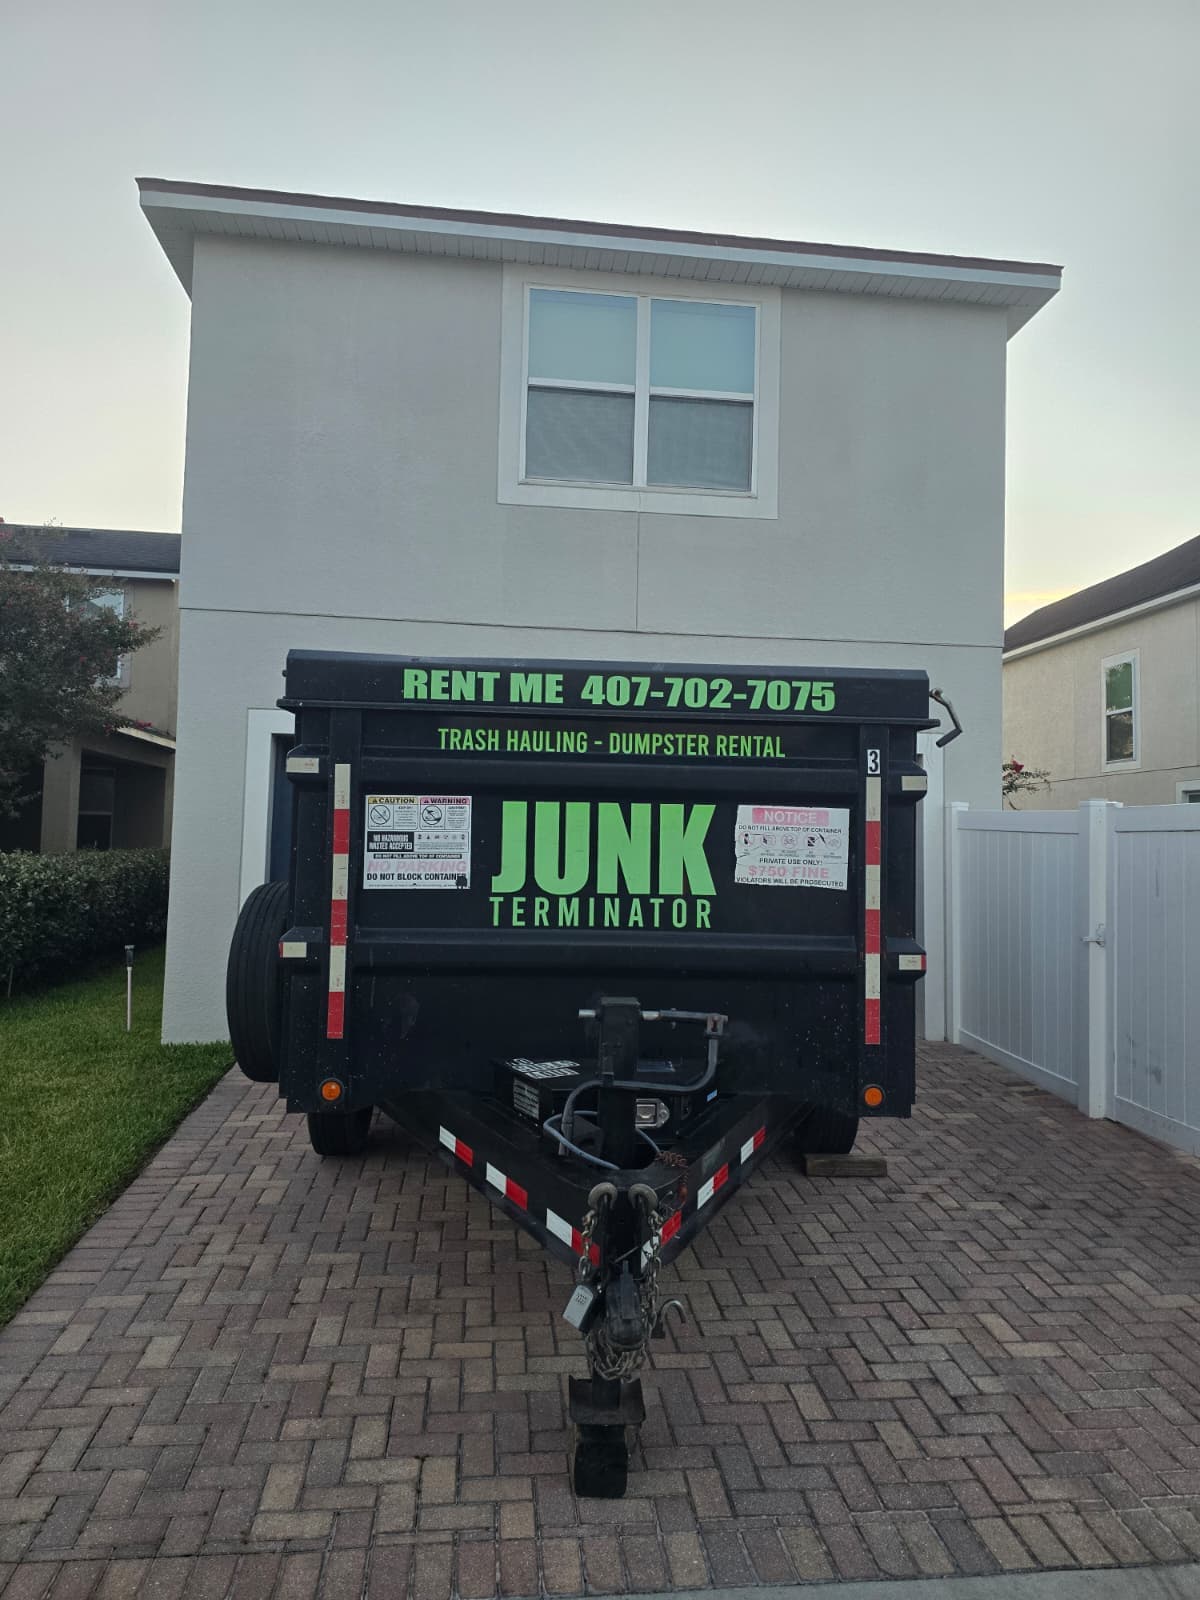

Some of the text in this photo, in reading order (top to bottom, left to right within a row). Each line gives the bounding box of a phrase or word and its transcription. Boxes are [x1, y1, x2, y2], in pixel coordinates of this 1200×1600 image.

[403, 669, 836, 711] RENT ME 407-702-7075
[438, 728, 499, 751] TRASH
[507, 729, 588, 753] HAULING
[609, 733, 709, 756] DUMPSTER
[716, 735, 786, 758] RENTAL
[868, 750, 880, 773] 3
[764, 809, 816, 824] NOTICE
[390, 842, 412, 850] ACCEPTED
[491, 801, 717, 895] JUNK
[368, 861, 467, 872] NO PARKING
[748, 865, 829, 878] $750 FINE
[424, 873, 466, 881] CONTAIN
[800, 879, 844, 887] PROSECUTED
[489, 897, 711, 928] TERMINATOR
